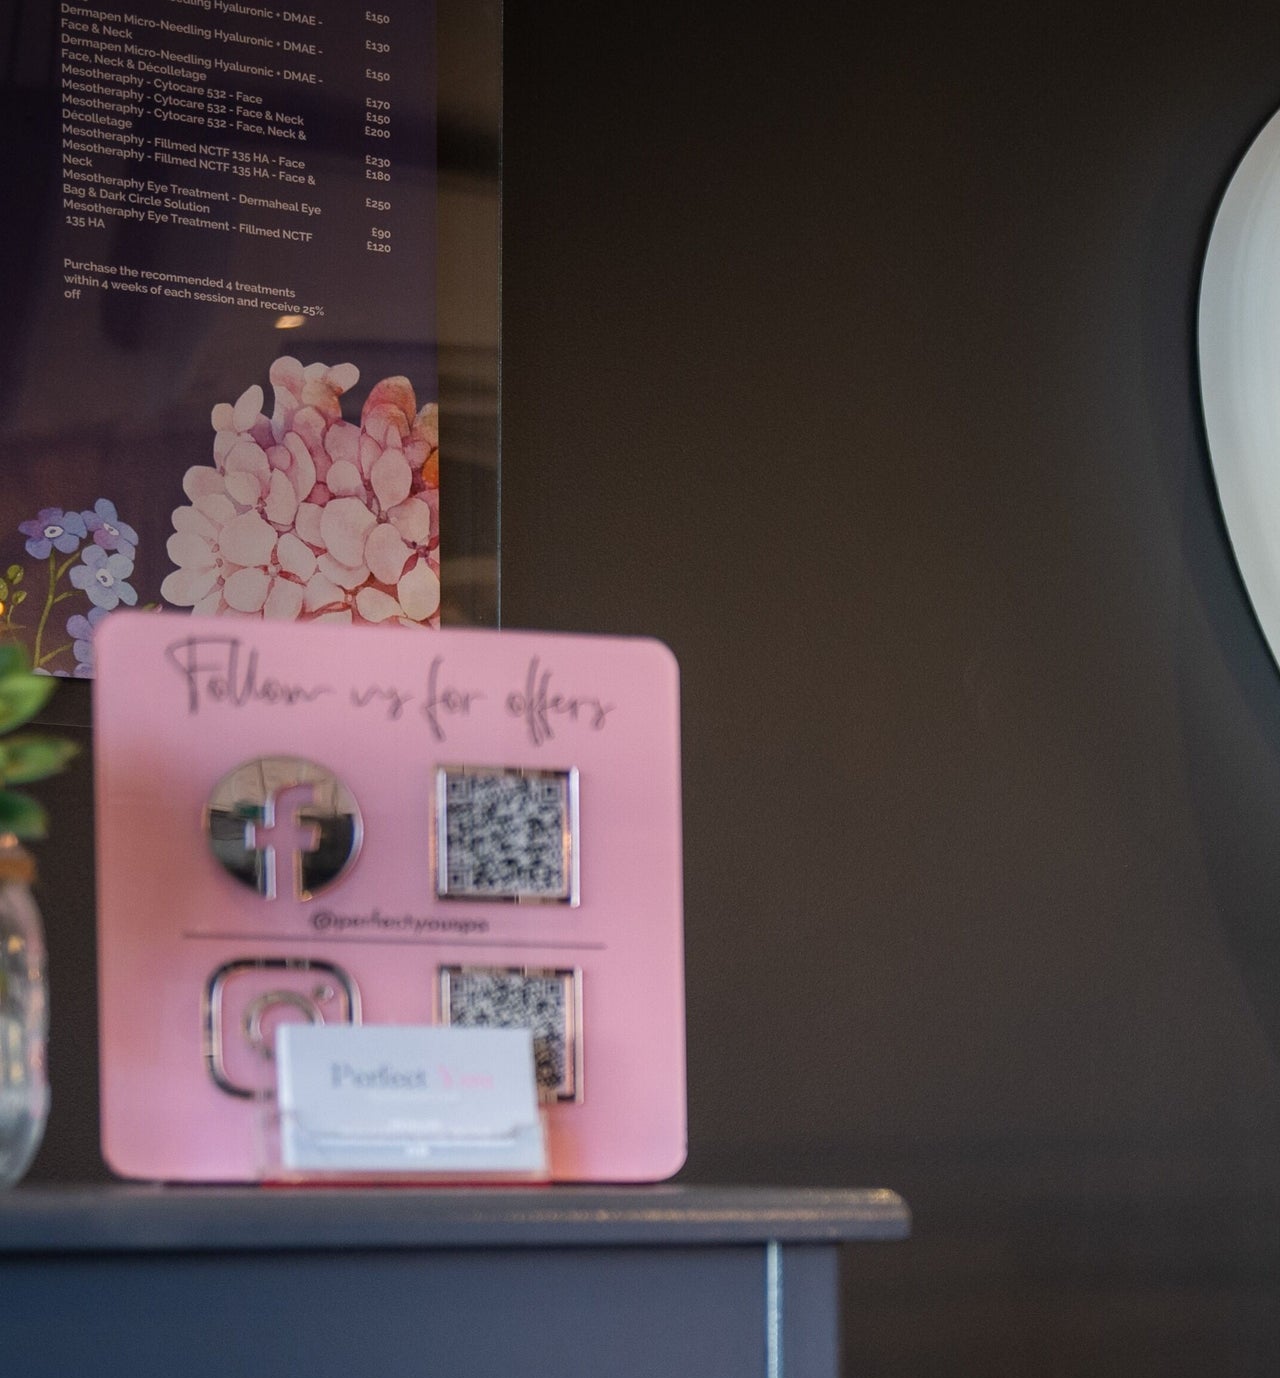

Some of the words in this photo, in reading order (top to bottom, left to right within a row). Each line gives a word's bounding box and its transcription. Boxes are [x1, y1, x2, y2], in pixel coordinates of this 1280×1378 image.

[213, 0, 274, 19] Hyaluronic
[282, 11, 316, 26] DMAE
[366, 11, 390, 24] £150
[60, 3, 122, 22] Dermapen
[124, 14, 212, 40] Micro-Needling
[214, 29, 274, 48] Hyaluronic
[283, 40, 316, 55] DMAE
[61, 18, 89, 32] Face
[91, 23, 100, 34] &
[102, 25, 133, 39] Neck
[366, 40, 390, 52] £130
[61, 48, 92, 63] Face,
[94, 53, 124, 67] Neck
[126, 59, 136, 69] &
[138, 60, 207, 82] Décolletage
[62, 33, 122, 52] Dermapen
[124, 43, 212, 69] Micro-Needling
[214, 58, 274, 77] Hyaluronic
[284, 70, 316, 84] DMAE
[62, 63, 144, 88] Mesotheraphy
[153, 78, 205, 95] Cytocare
[206, 88, 227, 99] 532
[236, 91, 263, 104] Face
[366, 69, 390, 82] £150
[62, 78, 144, 103] Mesotheraphy
[153, 93, 205, 110] Cytocare
[206, 103, 227, 114] 532
[236, 106, 263, 119] Face
[264, 110, 274, 121] &
[275, 112, 304, 126] Neck
[366, 98, 390, 110] £170
[62, 93, 144, 117] Mesotheraphy
[153, 108, 205, 125] Cytocare
[207, 118, 227, 128] 532
[236, 120, 265, 135] Face,
[267, 125, 296, 139] Neck
[298, 130, 307, 141] &
[62, 108, 133, 130] Décolletage
[366, 112, 390, 124] £150
[365, 126, 390, 138] £200
[62, 123, 144, 147] Mesotheraphy
[154, 137, 197, 153] Fillmed
[199, 144, 230, 157] NCTF
[232, 151, 251, 163] 135
[253, 152, 270, 164] HA
[278, 156, 306, 169] Face
[62, 153, 93, 167] Neck
[62, 138, 145, 162] Mesotheraphy
[154, 152, 197, 168] Fillmed
[199, 159, 230, 172] NCTF
[232, 165, 251, 177] 135
[253, 167, 270, 178] HA
[278, 171, 306, 184] Face
[307, 175, 316, 185] &
[365, 155, 390, 167] £230
[366, 170, 391, 182] £180
[62, 168, 145, 192] Mesotheraphy
[147, 180, 168, 194] Eye
[170, 184, 230, 202] Treatment
[238, 194, 300, 212] Dermaheal
[301, 203, 322, 216] Eye
[63, 183, 86, 198] Bag
[88, 187, 97, 197] &
[99, 188, 126, 202] Dark
[128, 193, 162, 206] Circle
[164, 198, 210, 213] Solution
[366, 198, 391, 210] £250
[63, 198, 146, 221] Mesotheraphy
[147, 210, 169, 224] Eye
[170, 213, 230, 231] Treatment
[239, 223, 281, 238] Fillmed
[282, 229, 313, 242] NCTF
[66, 216, 86, 227] 135
[88, 217, 106, 228] HA
[372, 228, 391, 239] £90
[366, 241, 391, 253] £120
[64, 258, 118, 274] Purchase
[119, 266, 139, 277] the
[140, 271, 224, 288] recommended
[225, 281, 233, 291] 4
[235, 281, 296, 298] treatments
[63, 289, 82, 299] off
[64, 274, 100, 287] within
[101, 280, 109, 290] 4
[110, 281, 148, 293] weeks
[150, 285, 162, 295] of
[164, 288, 192, 299] each
[193, 292, 235, 304] session
[236, 298, 258, 308] and
[260, 301, 301, 312] receive
[302, 306, 325, 317] 25%
[165, 636, 335, 715] Follow
[423, 654, 486, 742] for
[506, 654, 617, 747] offers
[331, 1062, 428, 1090] Perfect
